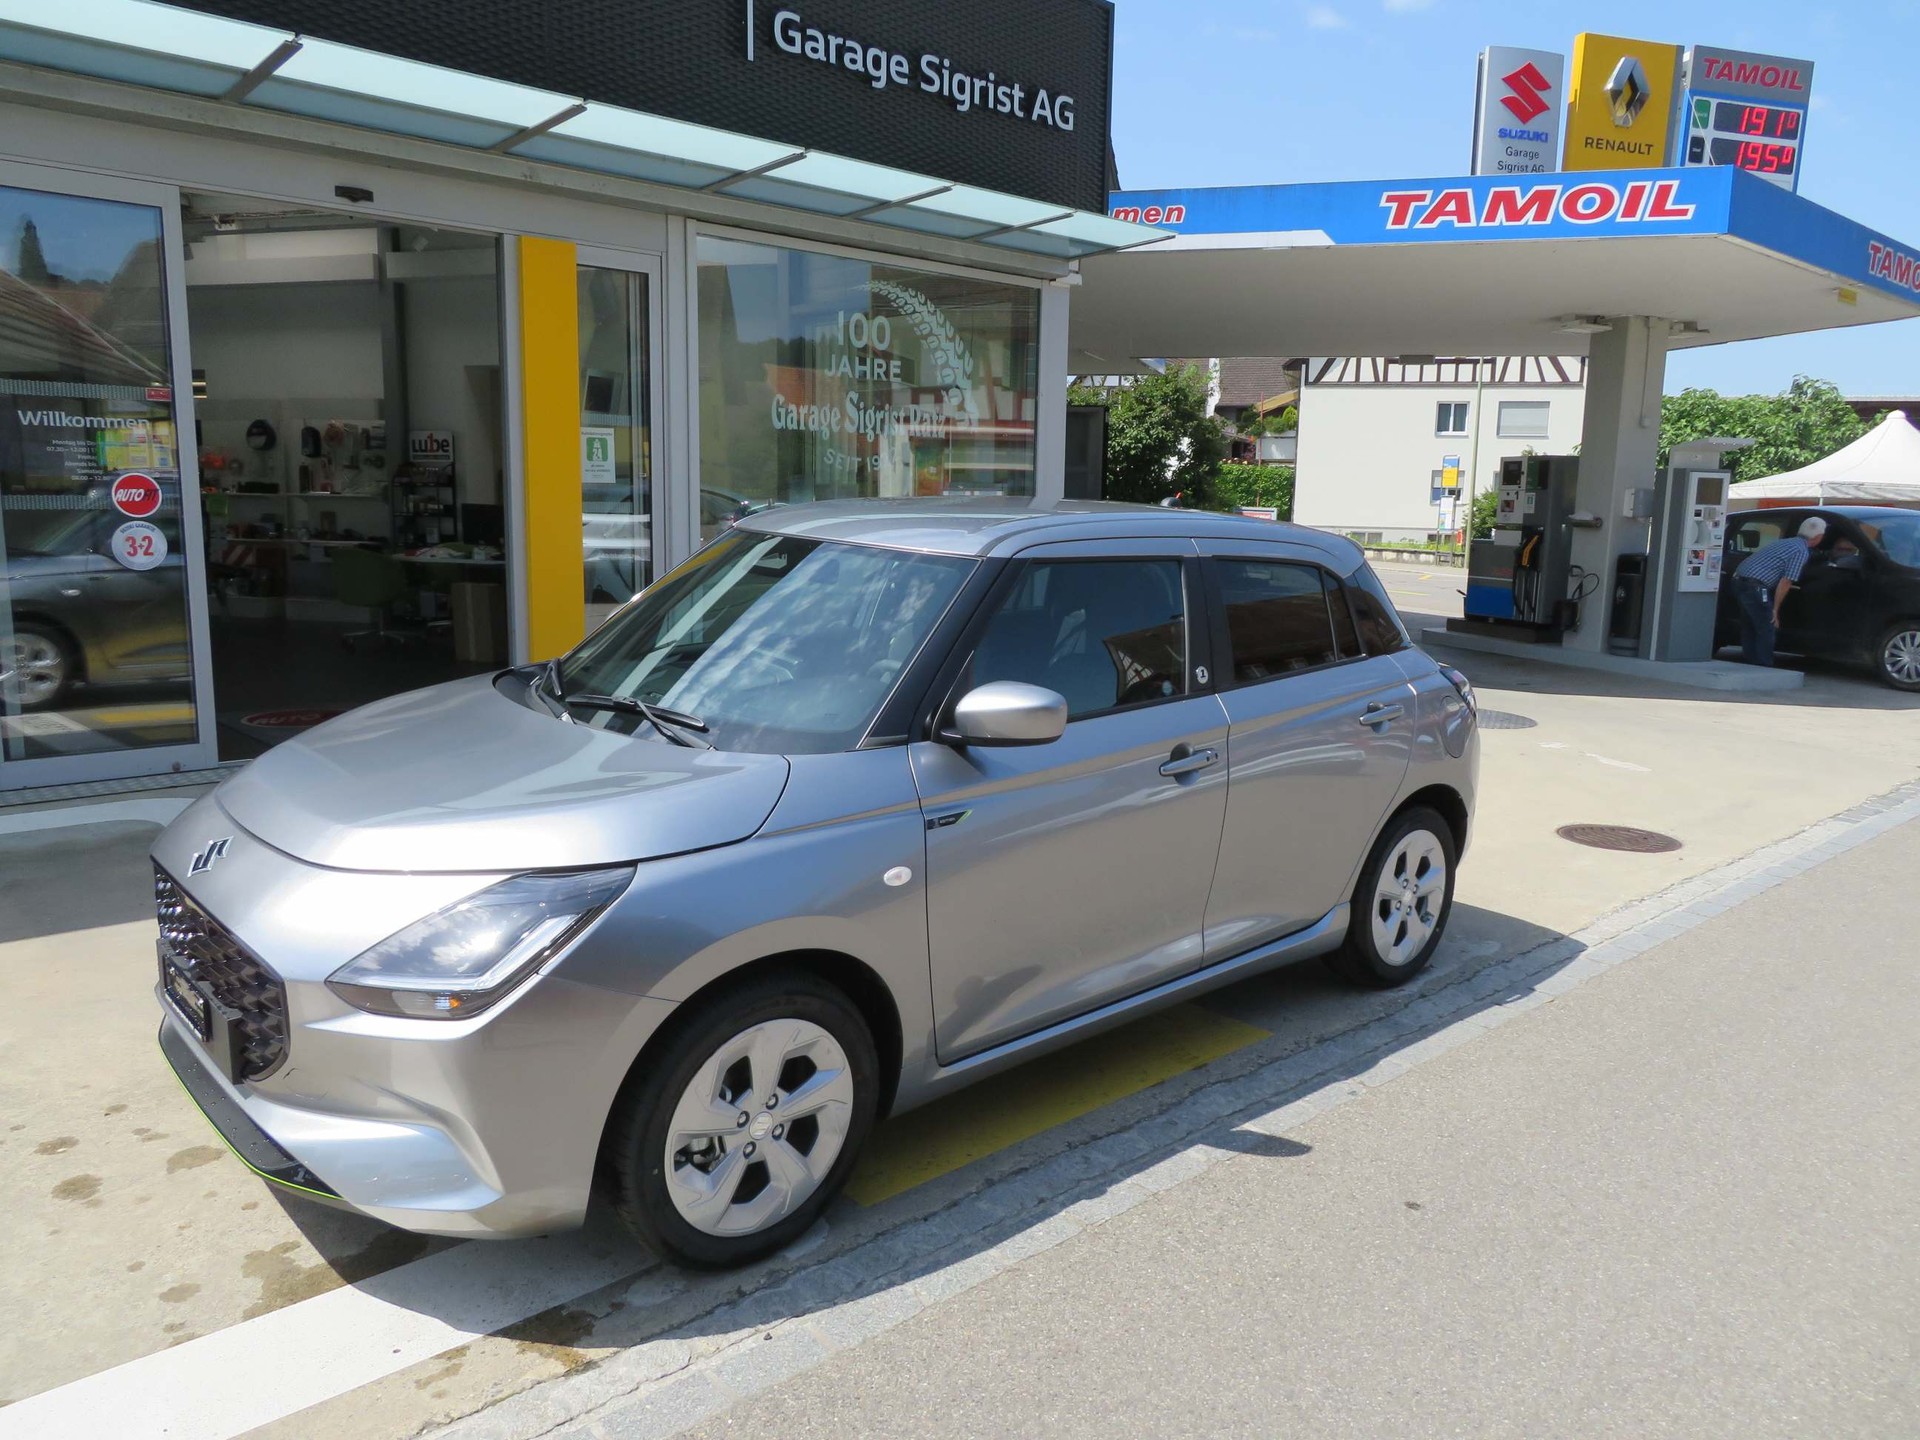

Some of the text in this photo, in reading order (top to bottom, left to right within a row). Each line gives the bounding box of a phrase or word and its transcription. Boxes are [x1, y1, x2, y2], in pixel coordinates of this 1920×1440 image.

[773, 11, 1075, 131] Garage Sigrist AG
[1703, 57, 1803, 91] TAMOIL
[1498, 127, 1549, 143] SUZUKI
[1584, 136, 1654, 156] RENAULT
[1505, 146, 1540, 160] Garage
[1497, 160, 1545, 173] Sigrist AG
[1379, 180, 1696, 229] TAMOIL
[838, 310, 891, 351] 100
[824, 353, 902, 383] JAHRE
[17, 409, 150, 429] Willkommen
[771, 394, 841, 441] Garage
[844, 390, 905, 442] Sigrist
[824, 448, 862, 473] SEIT
[125, 535, 154, 557] 3+2
